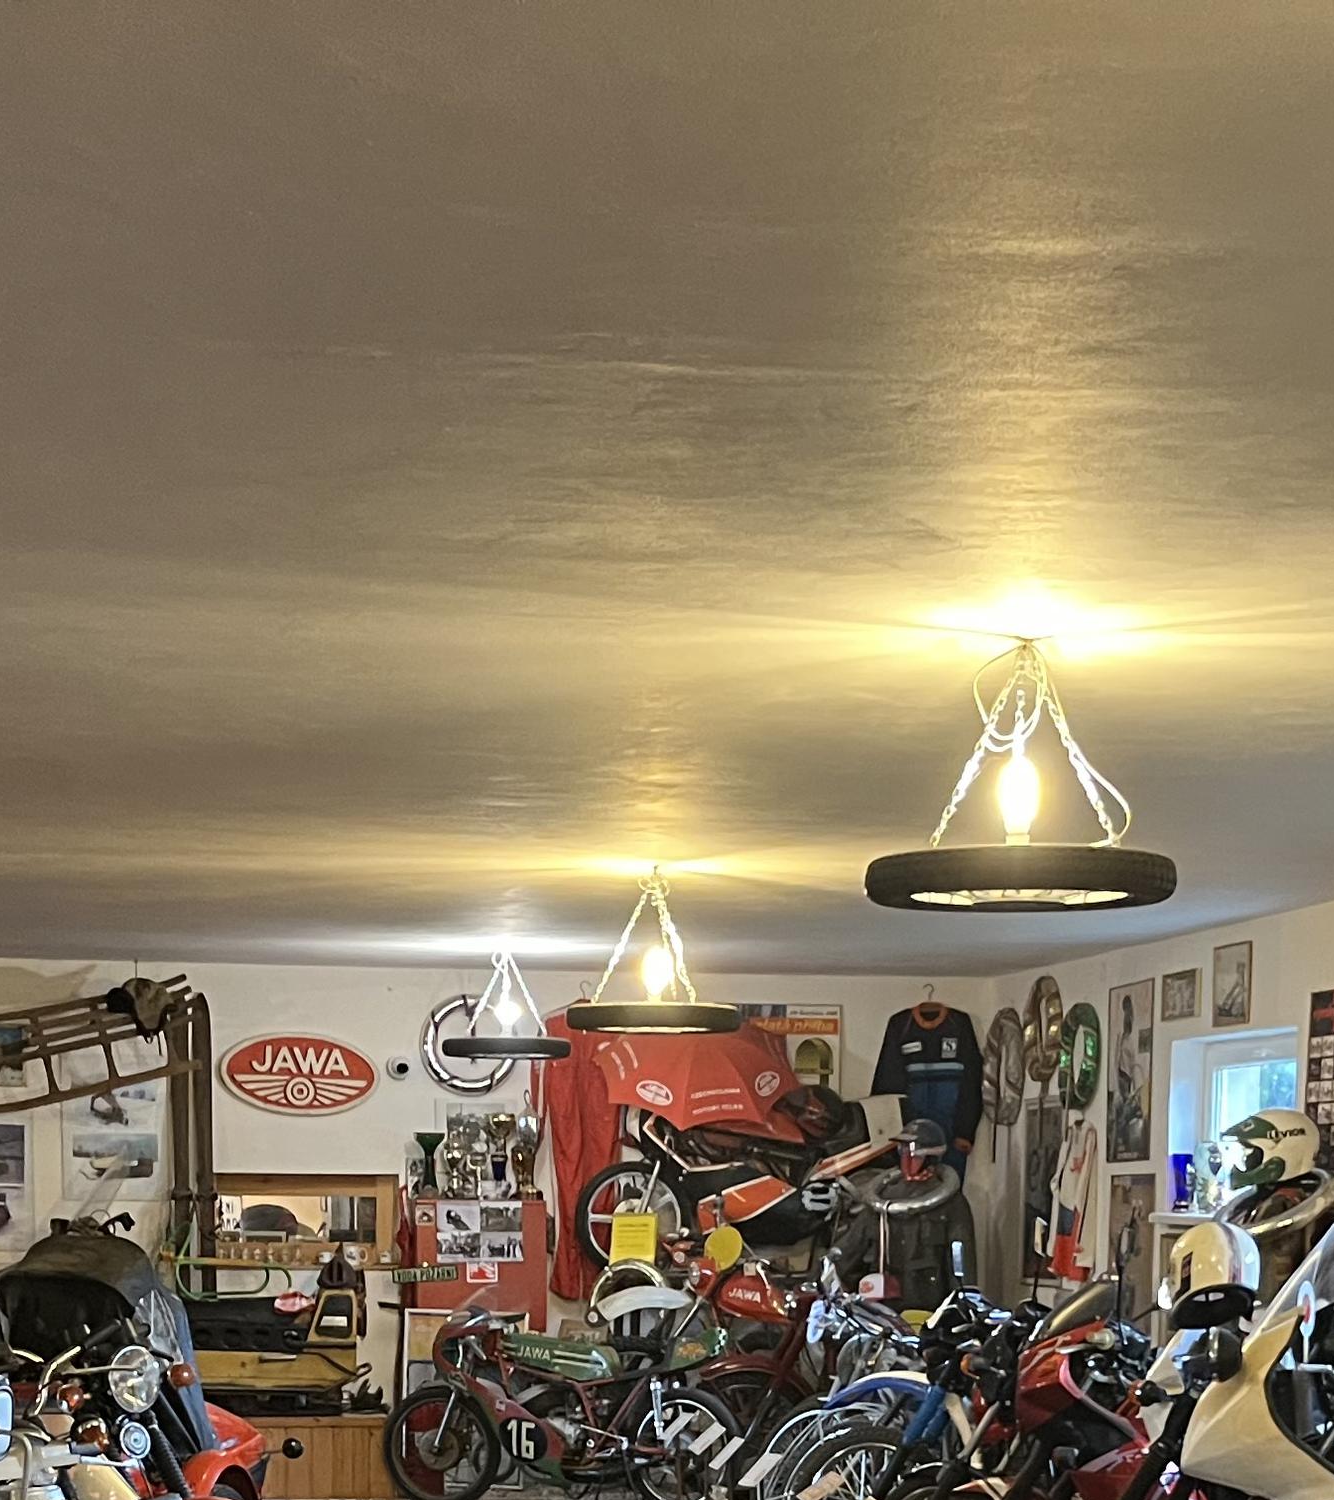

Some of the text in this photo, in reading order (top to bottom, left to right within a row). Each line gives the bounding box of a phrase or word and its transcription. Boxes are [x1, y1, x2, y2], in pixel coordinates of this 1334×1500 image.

[251, 1044, 350, 1077] JAWA
[727, 1286, 762, 1304] JAWA
[517, 1345, 551, 1362] JAWA
[506, 1418, 536, 1460] 16
